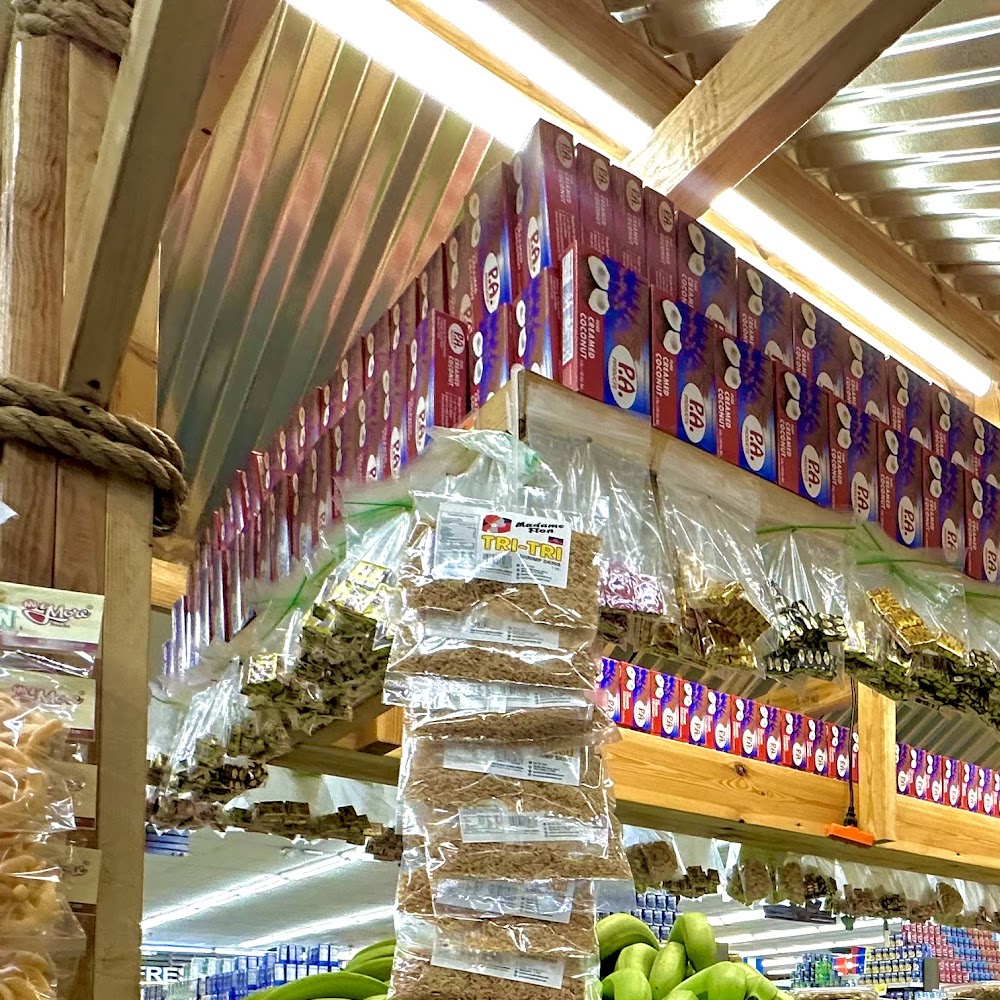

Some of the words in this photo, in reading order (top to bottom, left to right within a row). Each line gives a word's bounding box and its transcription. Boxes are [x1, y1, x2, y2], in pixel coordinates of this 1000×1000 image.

[488, 265, 499, 306] P.A.
[453, 329, 464, 350] P.A.
[579, 312, 588, 360] COCONUT
[587, 315, 596, 360] CREAMED
[618, 361, 636, 398] P.A.
[662, 356, 670, 397] CREAMED
[689, 398, 705, 432] P.A.
[717, 388, 725, 430] COCONUT
[724, 391, 732, 429] CREAMED
[749, 429, 764, 461] P.A.
[808, 458, 820, 489] P.A.
[857, 485, 870, 514] P.A.
[515, 521, 565, 530] Madame
[904, 509, 915, 537] P.A.
[481, 534, 564, 563] TRI-TRI
[987, 550, 997, 575] P.A.
